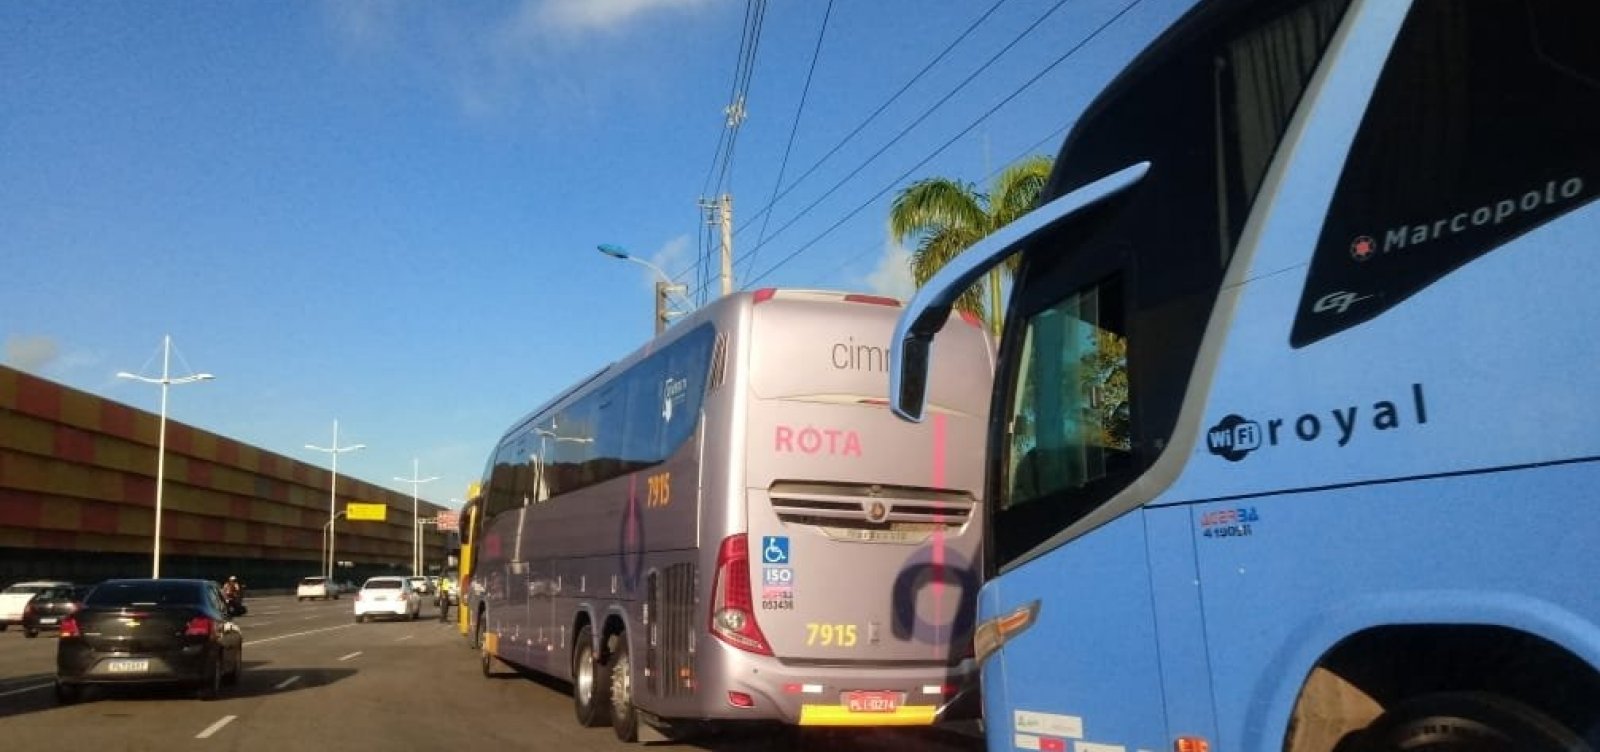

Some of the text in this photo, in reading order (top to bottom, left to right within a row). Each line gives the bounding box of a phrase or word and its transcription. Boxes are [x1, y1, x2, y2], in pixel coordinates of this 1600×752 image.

[1383, 177, 1583, 253] Marcopolo
[1268, 383, 1427, 447] royal
[775, 424, 862, 456] ROTA
[647, 472, 670, 508] 7915
[766, 569, 791, 582] ISO
[806, 623, 857, 647] 7915
